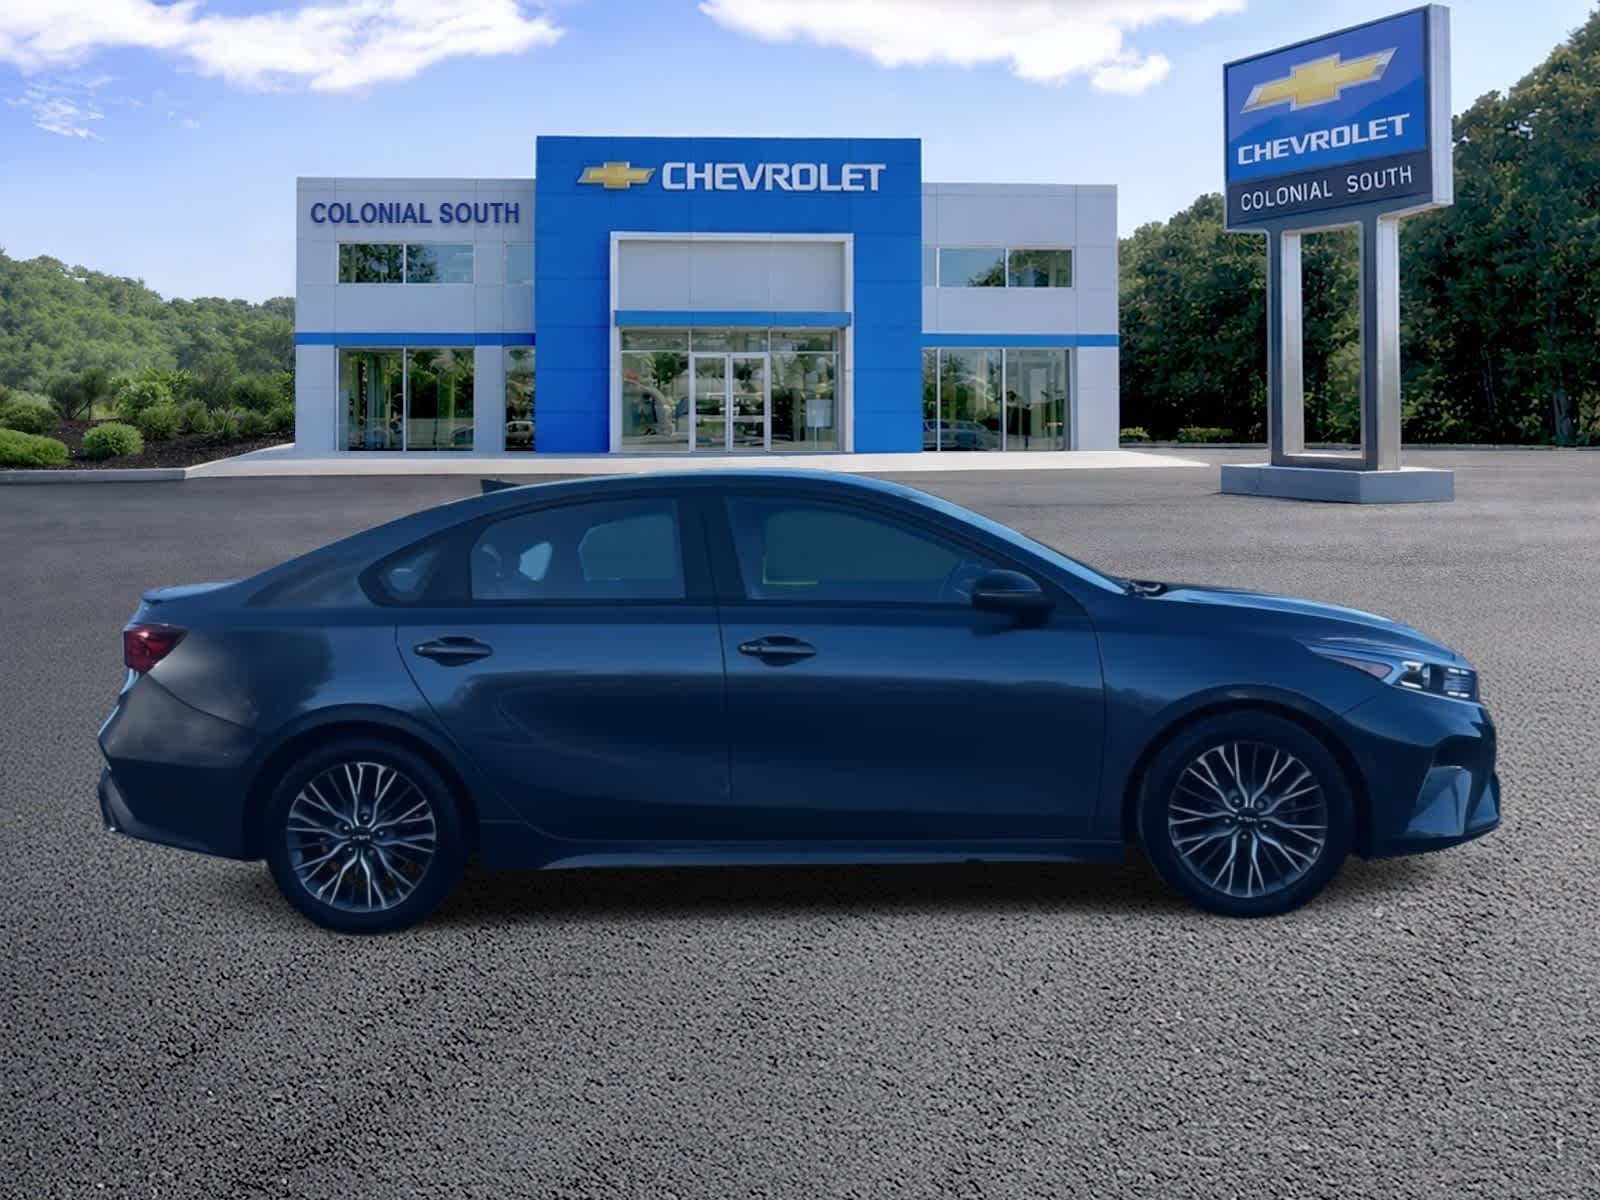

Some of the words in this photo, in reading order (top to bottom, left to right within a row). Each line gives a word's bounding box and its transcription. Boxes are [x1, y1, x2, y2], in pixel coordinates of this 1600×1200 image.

[1238, 114, 1410, 165] CHEVROLET
[662, 162, 886, 192] CHEVROLET
[1241, 179, 1333, 211] COLONIAL
[1347, 165, 1412, 193] SOUTH
[310, 202, 432, 224] COLONIAL
[439, 202, 520, 224] SOUTH
